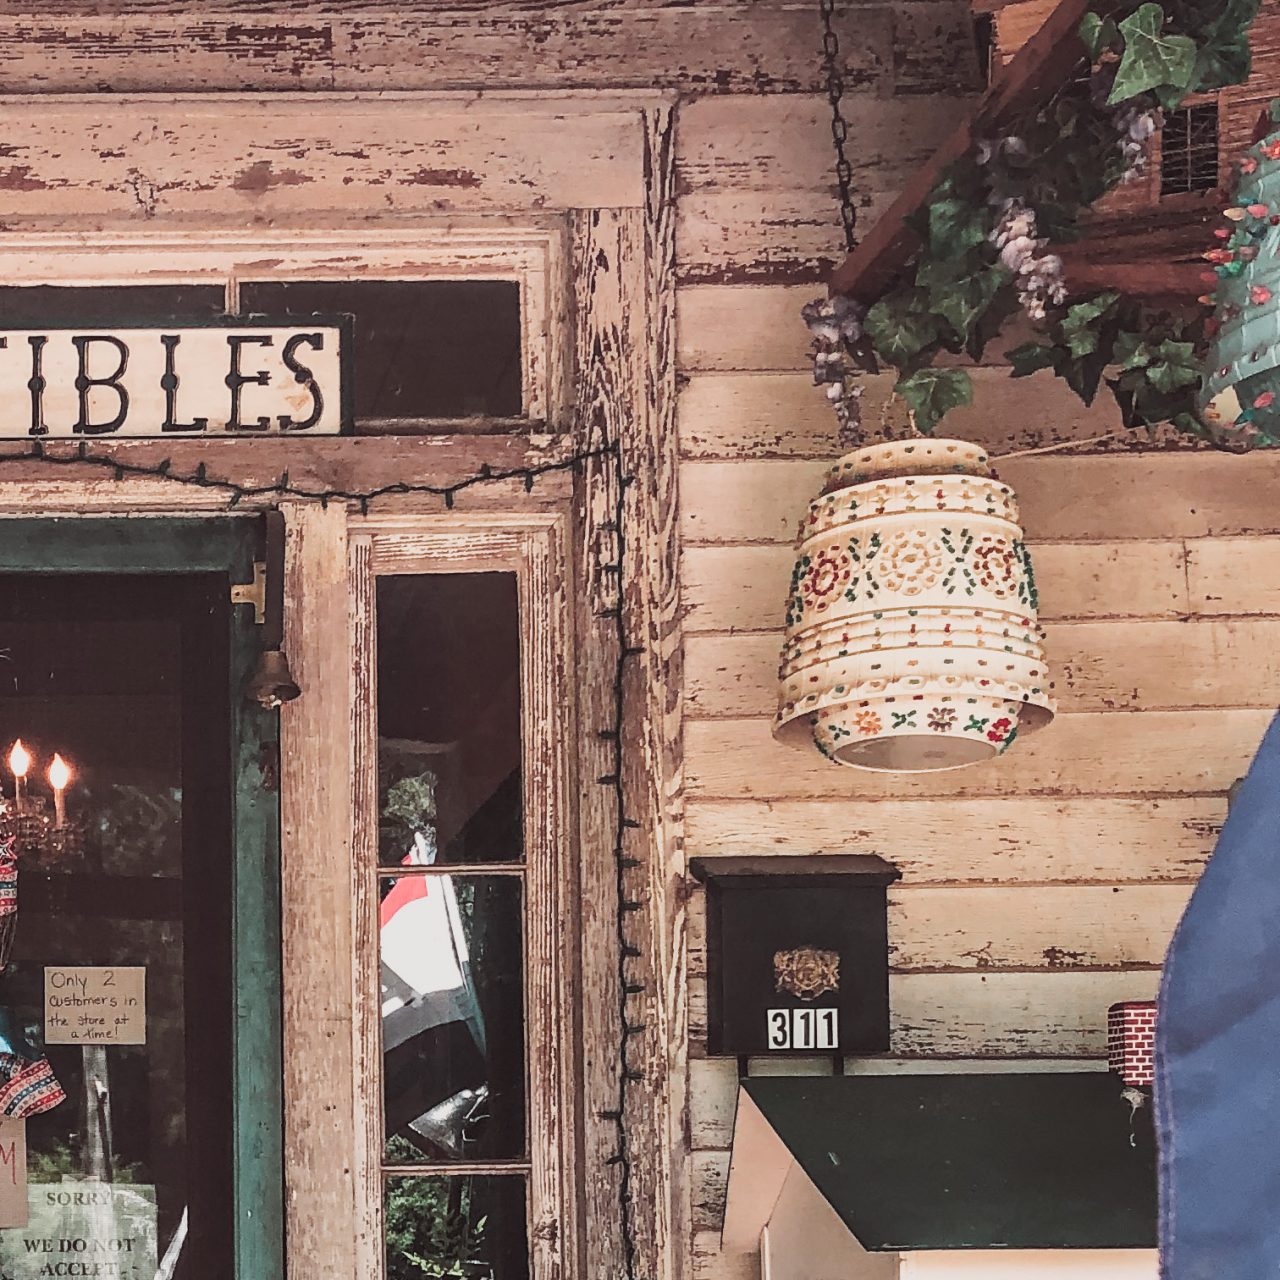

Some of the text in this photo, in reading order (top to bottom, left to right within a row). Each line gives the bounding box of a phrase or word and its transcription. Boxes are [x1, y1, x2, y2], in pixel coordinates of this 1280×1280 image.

[51, 970, 116, 997] Only 2
[124, 994, 137, 1007] in
[47, 1012, 129, 1027] the store at
[70, 1025, 119, 1039] a time!
[771, 1011, 834, 1047] 311
[23, 1238, 137, 1253] WE DO NOT
